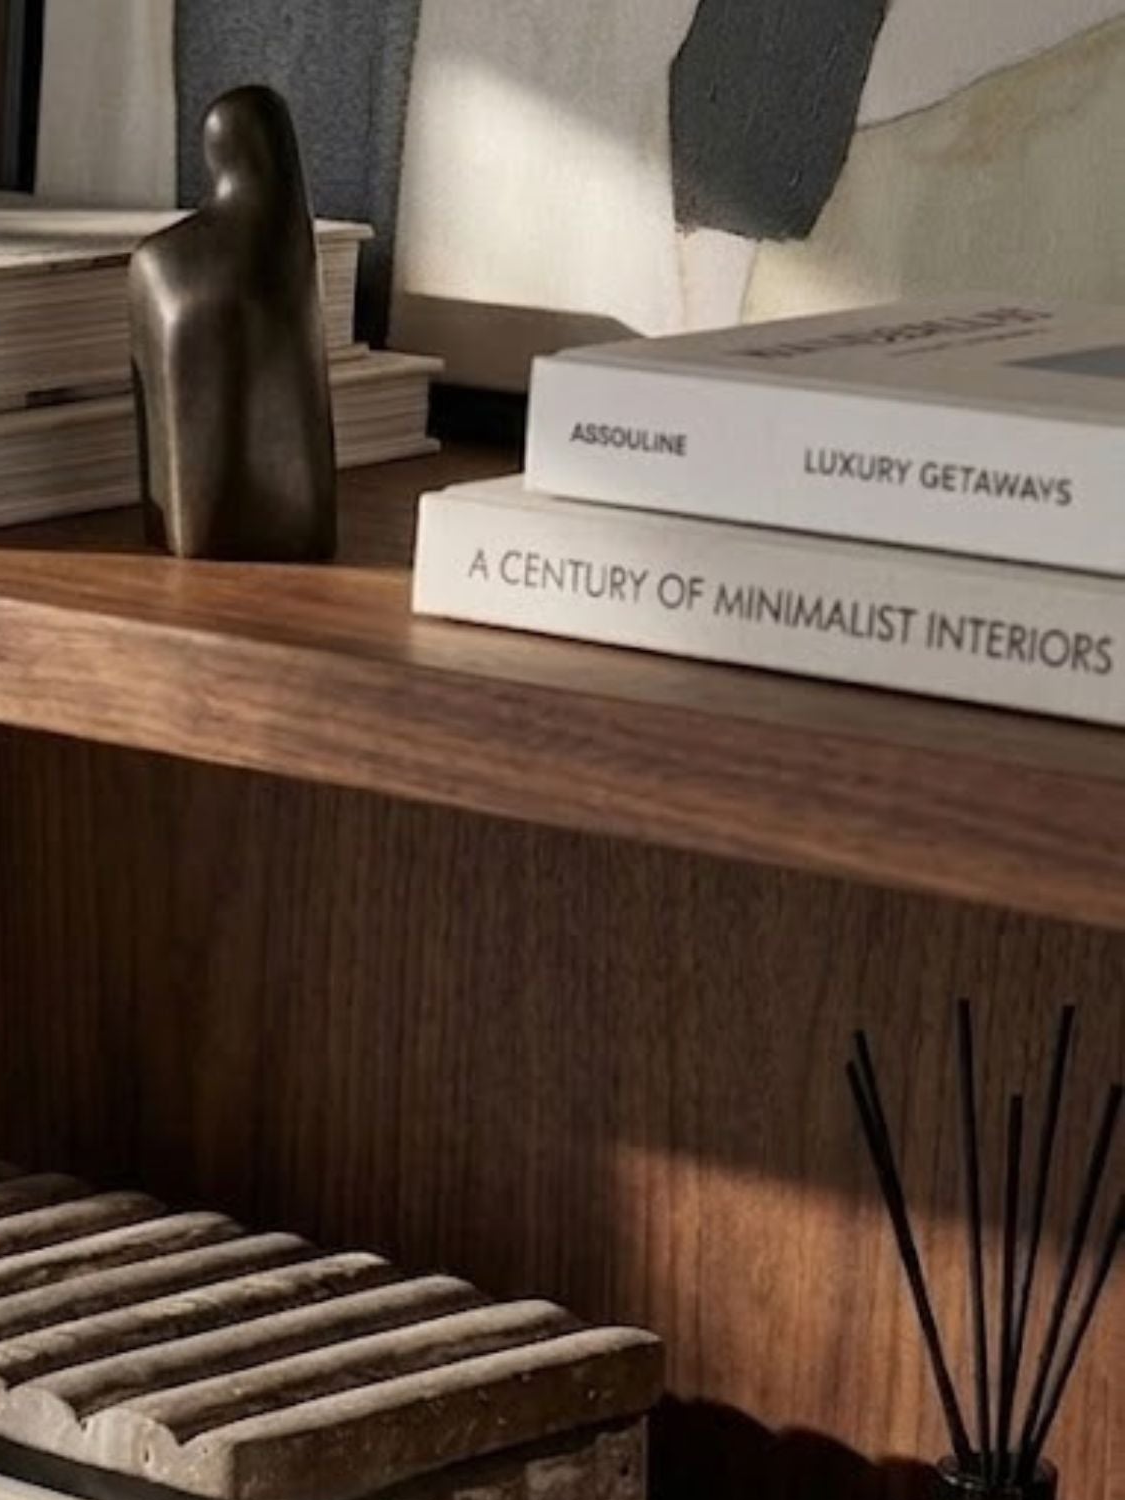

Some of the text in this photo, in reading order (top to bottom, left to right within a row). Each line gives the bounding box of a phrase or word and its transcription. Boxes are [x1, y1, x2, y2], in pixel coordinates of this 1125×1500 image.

[569, 421, 687, 457] ASSOULINE
[804, 448, 1073, 506] LUXURY GETAWAYS
[469, 549, 1113, 675] A CENTURY OF MINIMALIST INTERIORS
